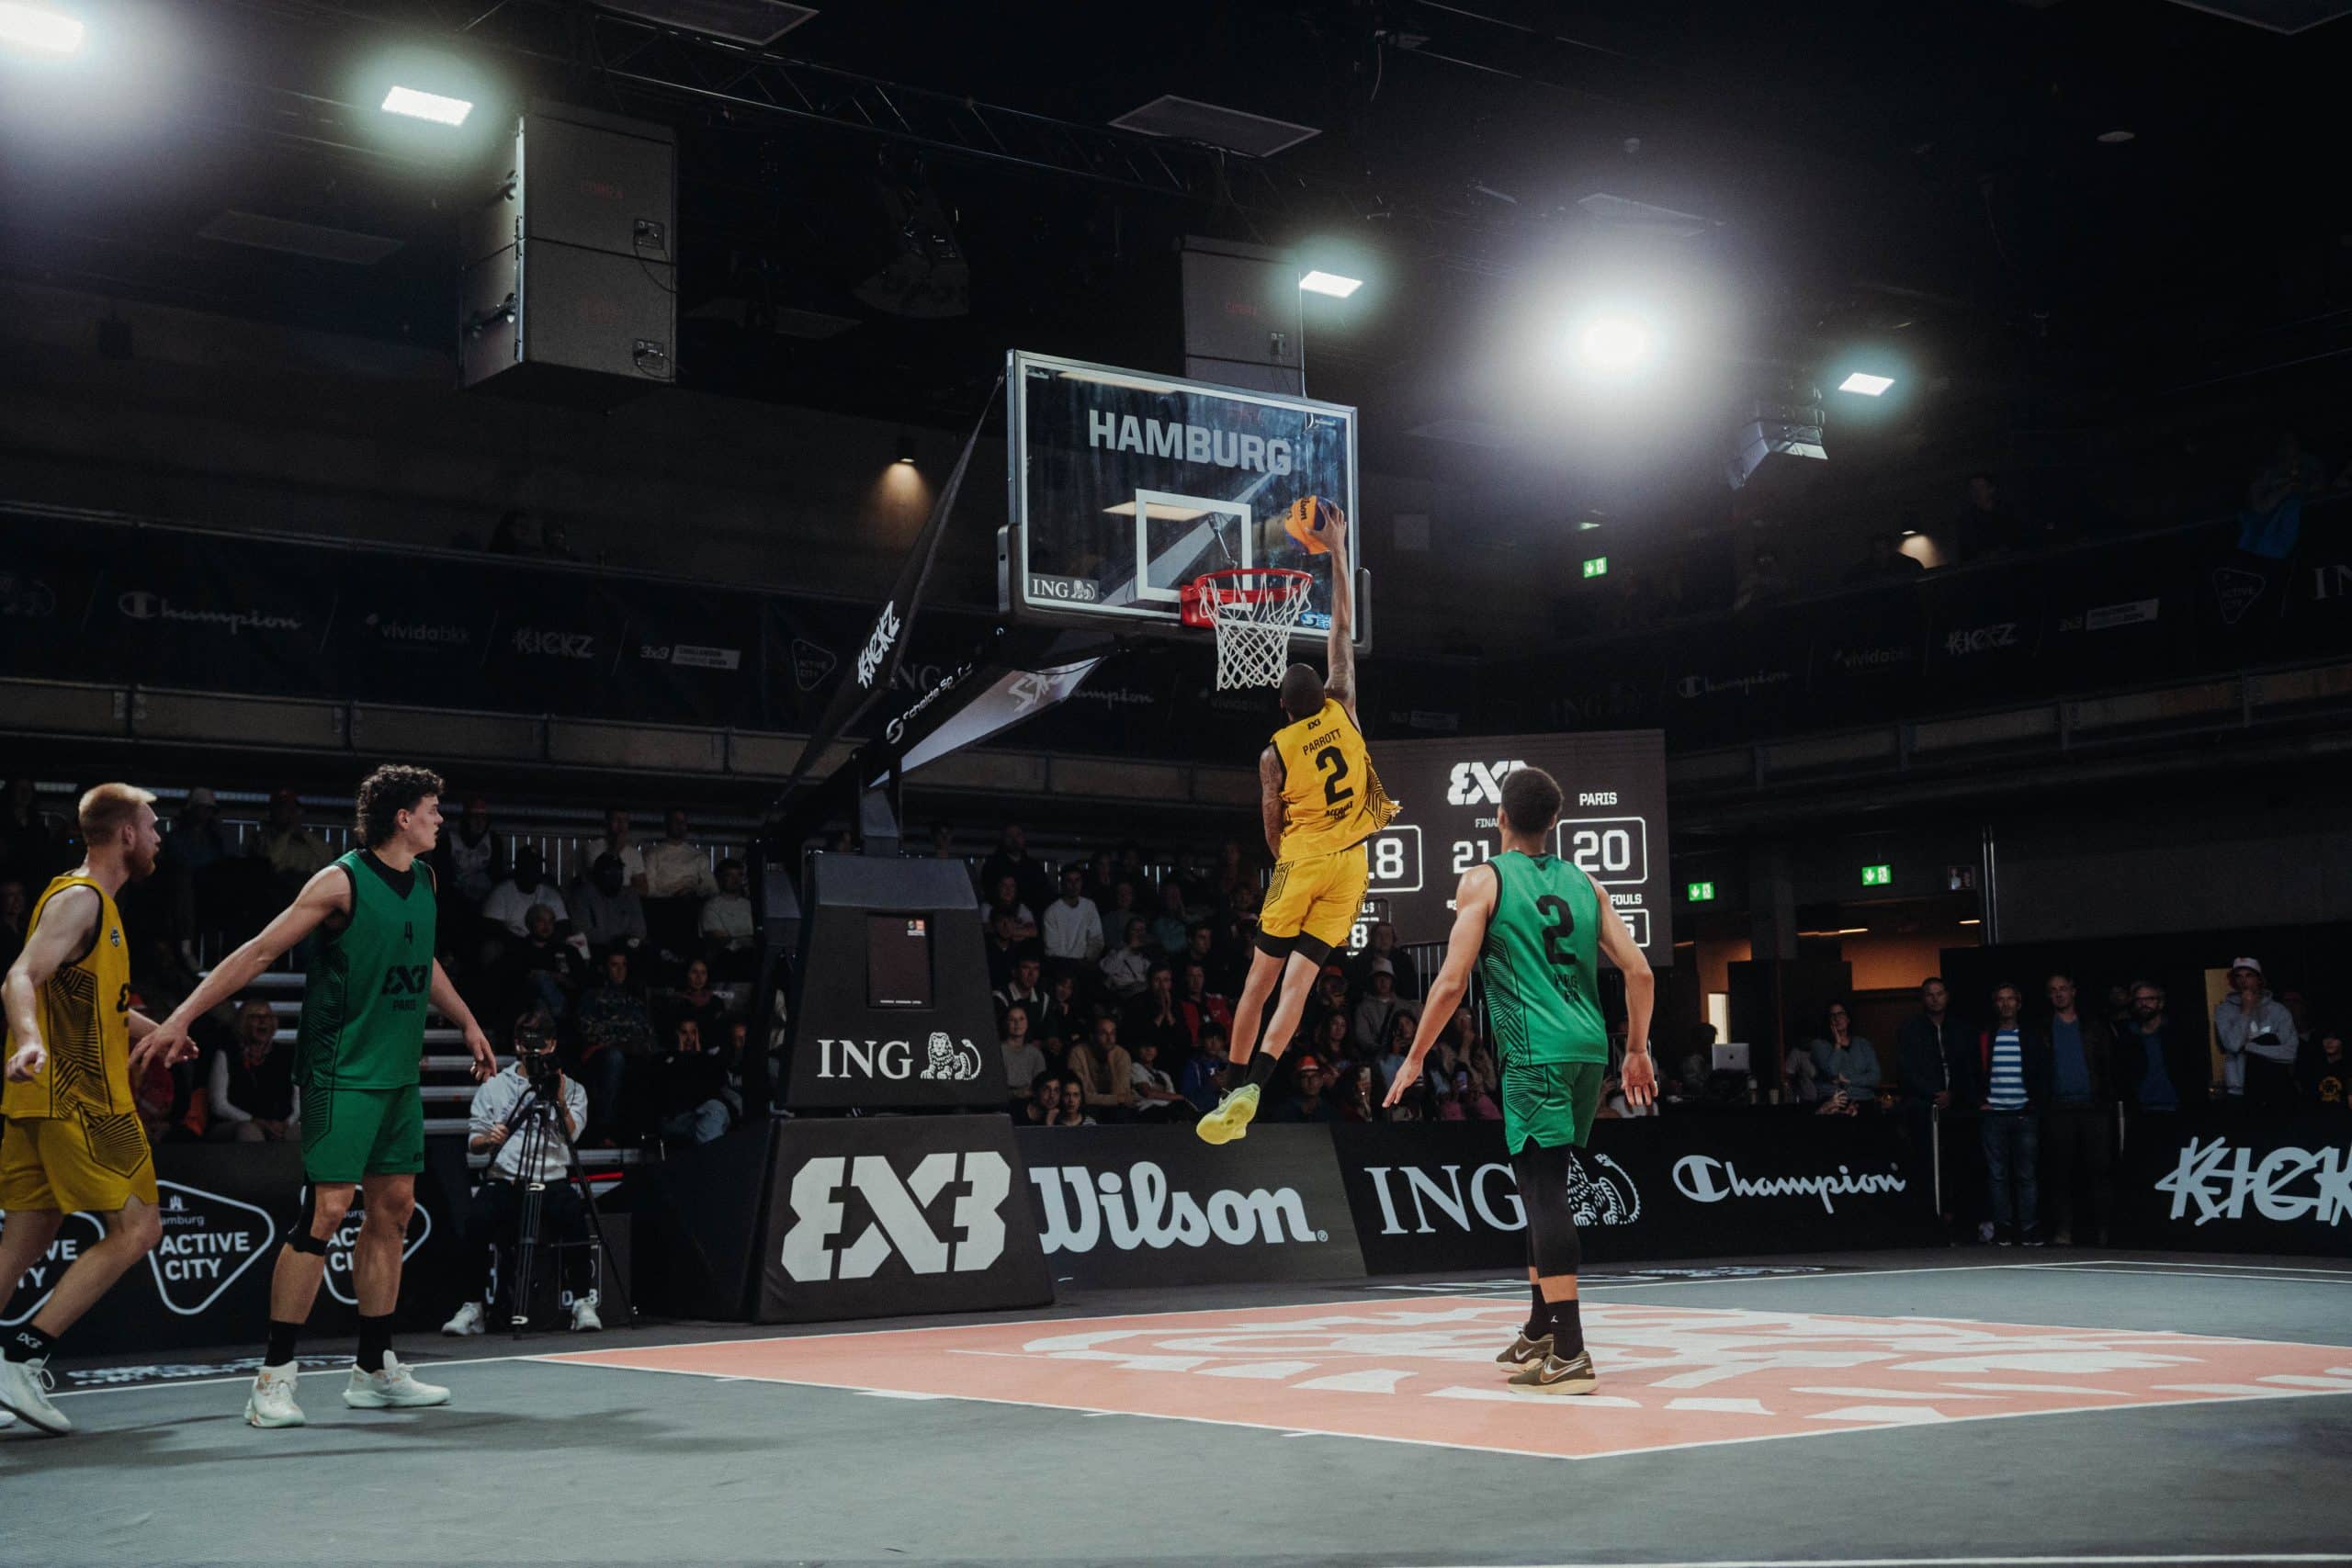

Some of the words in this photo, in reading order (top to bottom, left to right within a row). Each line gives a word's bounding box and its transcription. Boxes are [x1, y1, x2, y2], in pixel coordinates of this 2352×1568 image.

[1090, 410, 1292, 476] HAMBURG
[1032, 578, 1069, 599] ING
[118, 591, 303, 636] Champion
[512, 625, 597, 660] KICKZ
[857, 600, 901, 689] KICKZ
[1945, 622, 2019, 656] KICKZ
[1678, 669, 1792, 699] Champion
[1063, 689, 1155, 722] ampion
[1302, 728, 1341, 756] PARROTT
[1316, 746, 1354, 806] 2
[1579, 792, 1618, 807] PARIS
[1475, 817, 1500, 829] FINA
[1573, 829, 1630, 872] 20
[1610, 893, 1643, 905] FOULS
[1536, 895, 1577, 964] 2
[817, 1039, 914, 1079] ING
[1363, 1162, 1530, 1235] ING
[1672, 1154, 1906, 1214] Champion
[160, 1214, 205, 1226] amburg
[159, 1231, 251, 1256] ACTIVE
[164, 1258, 221, 1280] CITY
